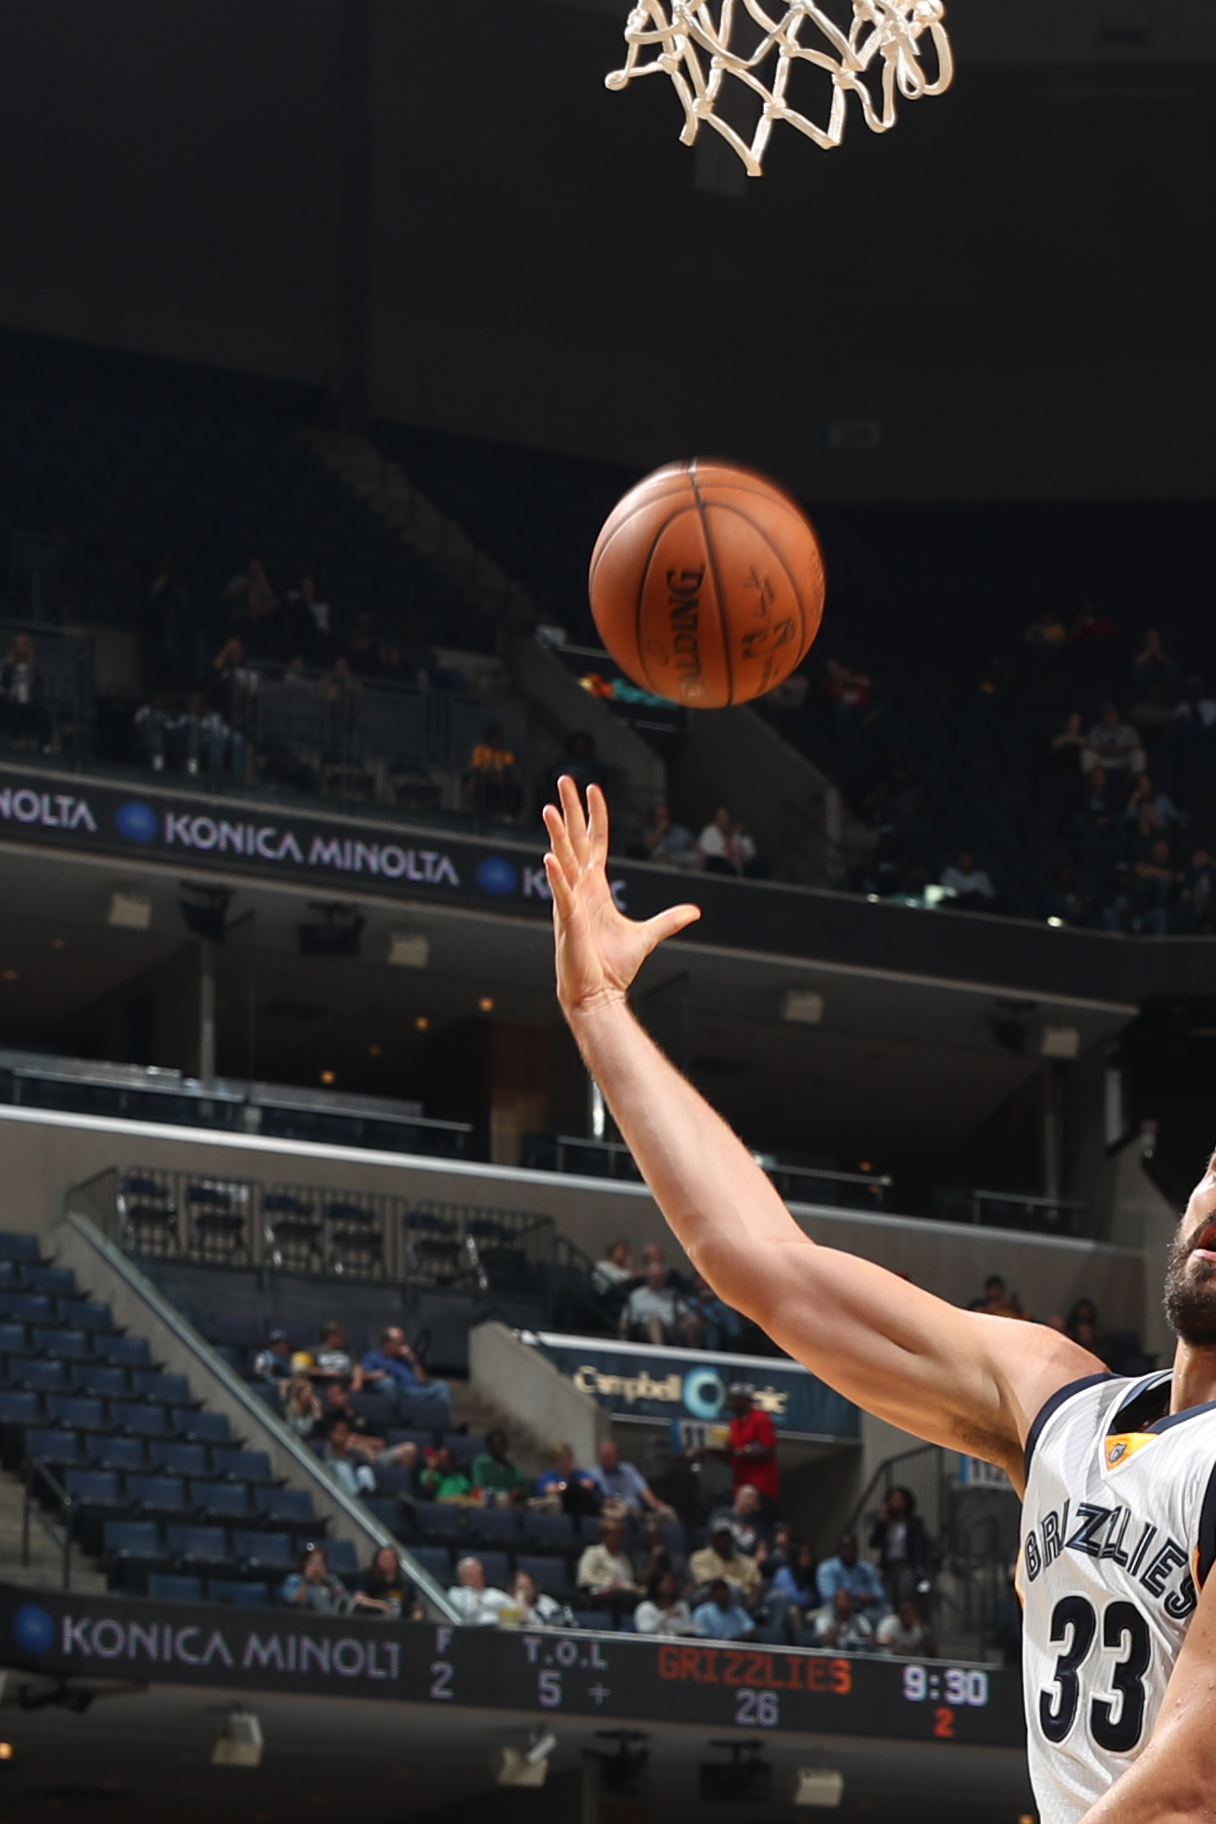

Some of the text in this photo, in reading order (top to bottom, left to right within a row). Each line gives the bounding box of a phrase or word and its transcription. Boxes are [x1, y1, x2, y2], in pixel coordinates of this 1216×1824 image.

[165, 811, 460, 887] KONICA MINOLTA
[1024, 1498, 1197, 1620] GRIZZLIES
[62, 1615, 233, 1668] KONICA
[436, 1627, 454, 1654] F
[430, 1661, 454, 1698] 2
[538, 1669, 562, 1707] 5
[658, 1646, 852, 1694] GRIZZLIES
[904, 1664, 989, 1706] 9:30
[1039, 1594, 1151, 1754] 33
[735, 1688, 779, 1727] 26
[934, 1708, 955, 1738] 2
